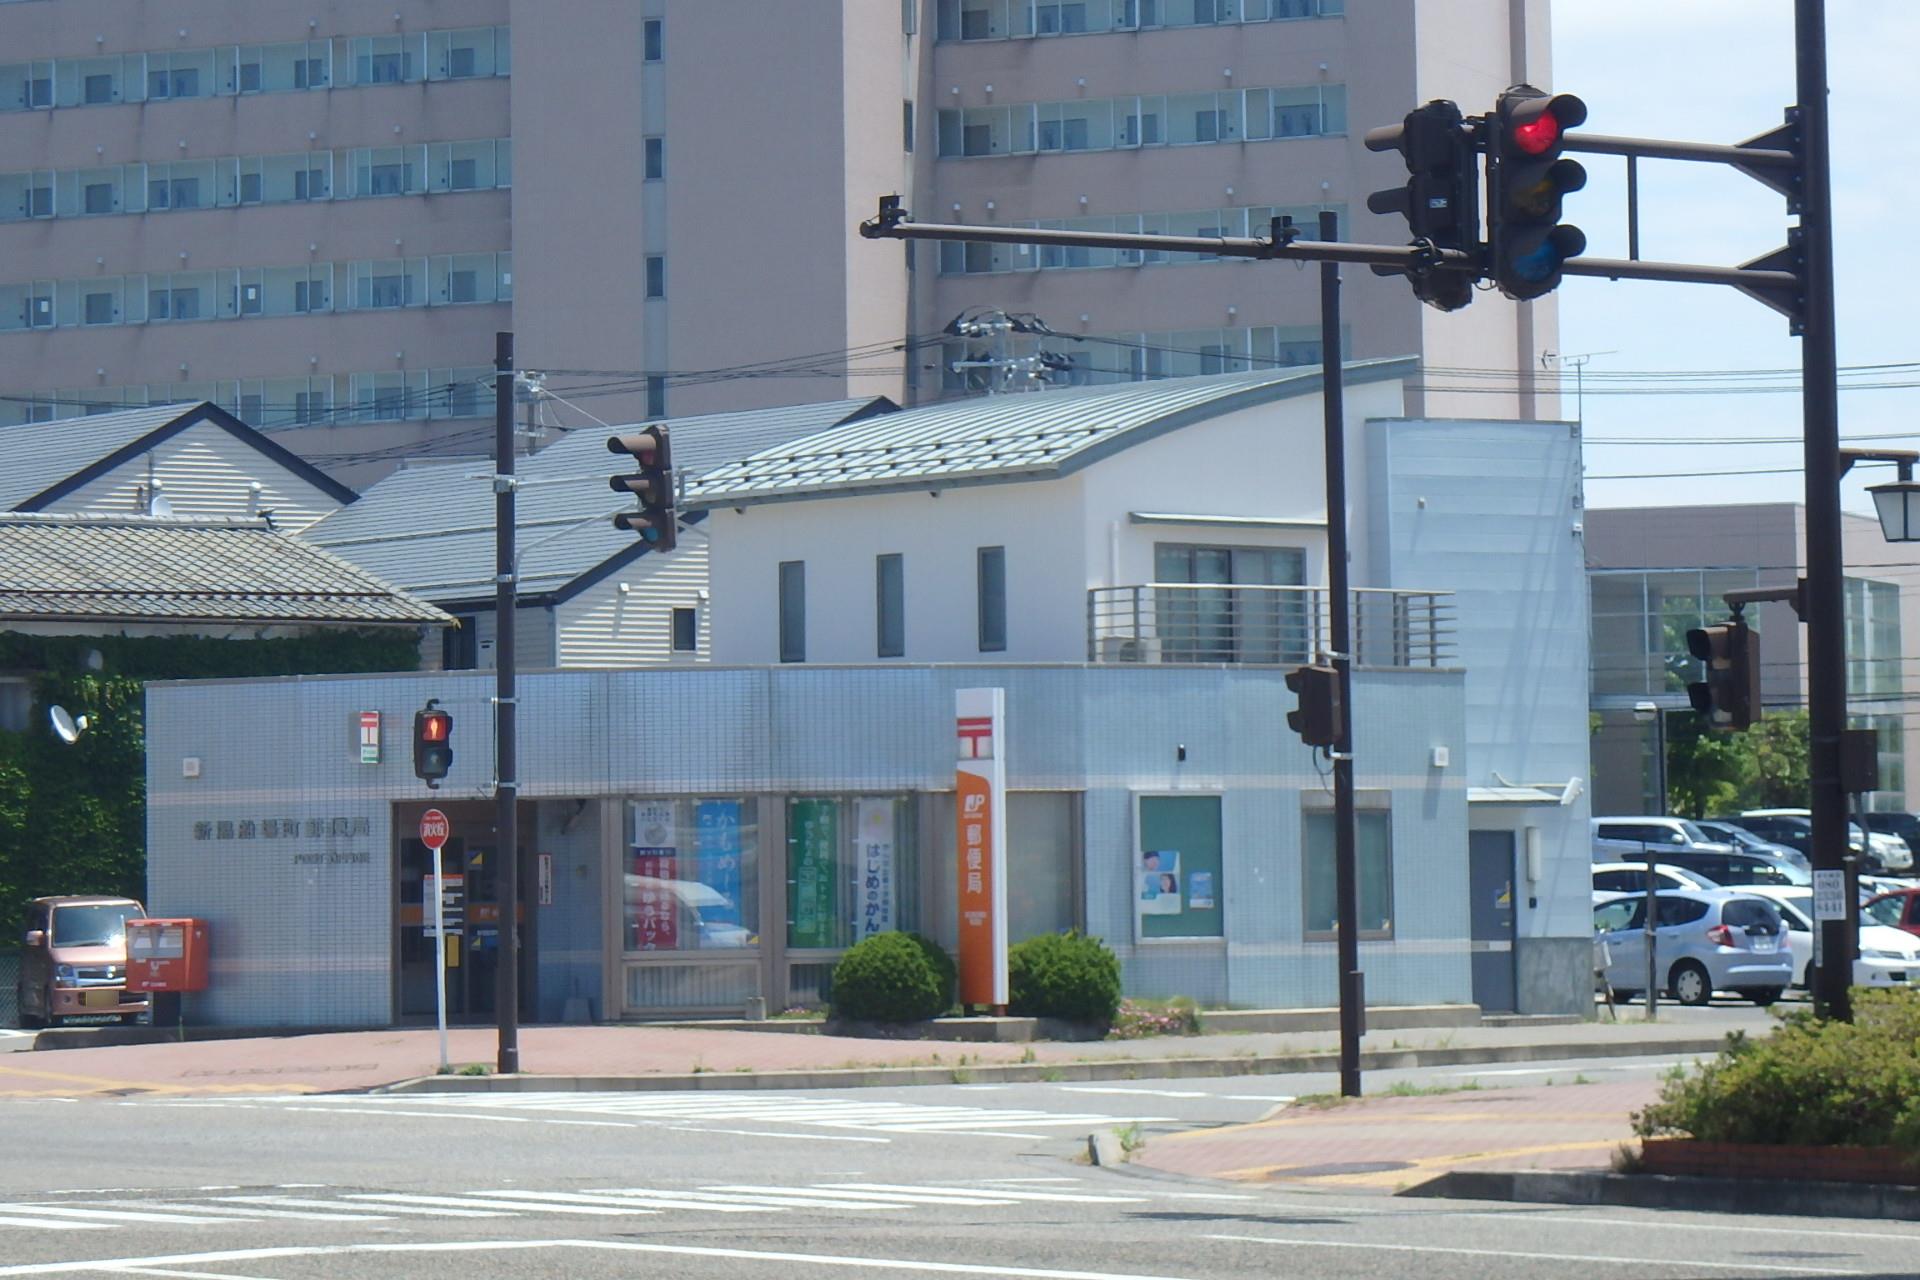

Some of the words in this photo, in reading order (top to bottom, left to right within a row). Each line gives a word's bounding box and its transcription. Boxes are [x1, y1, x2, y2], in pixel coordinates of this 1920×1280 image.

[865, 843, 880, 938] はじめのかん
[966, 823, 982, 894] 郵便局
